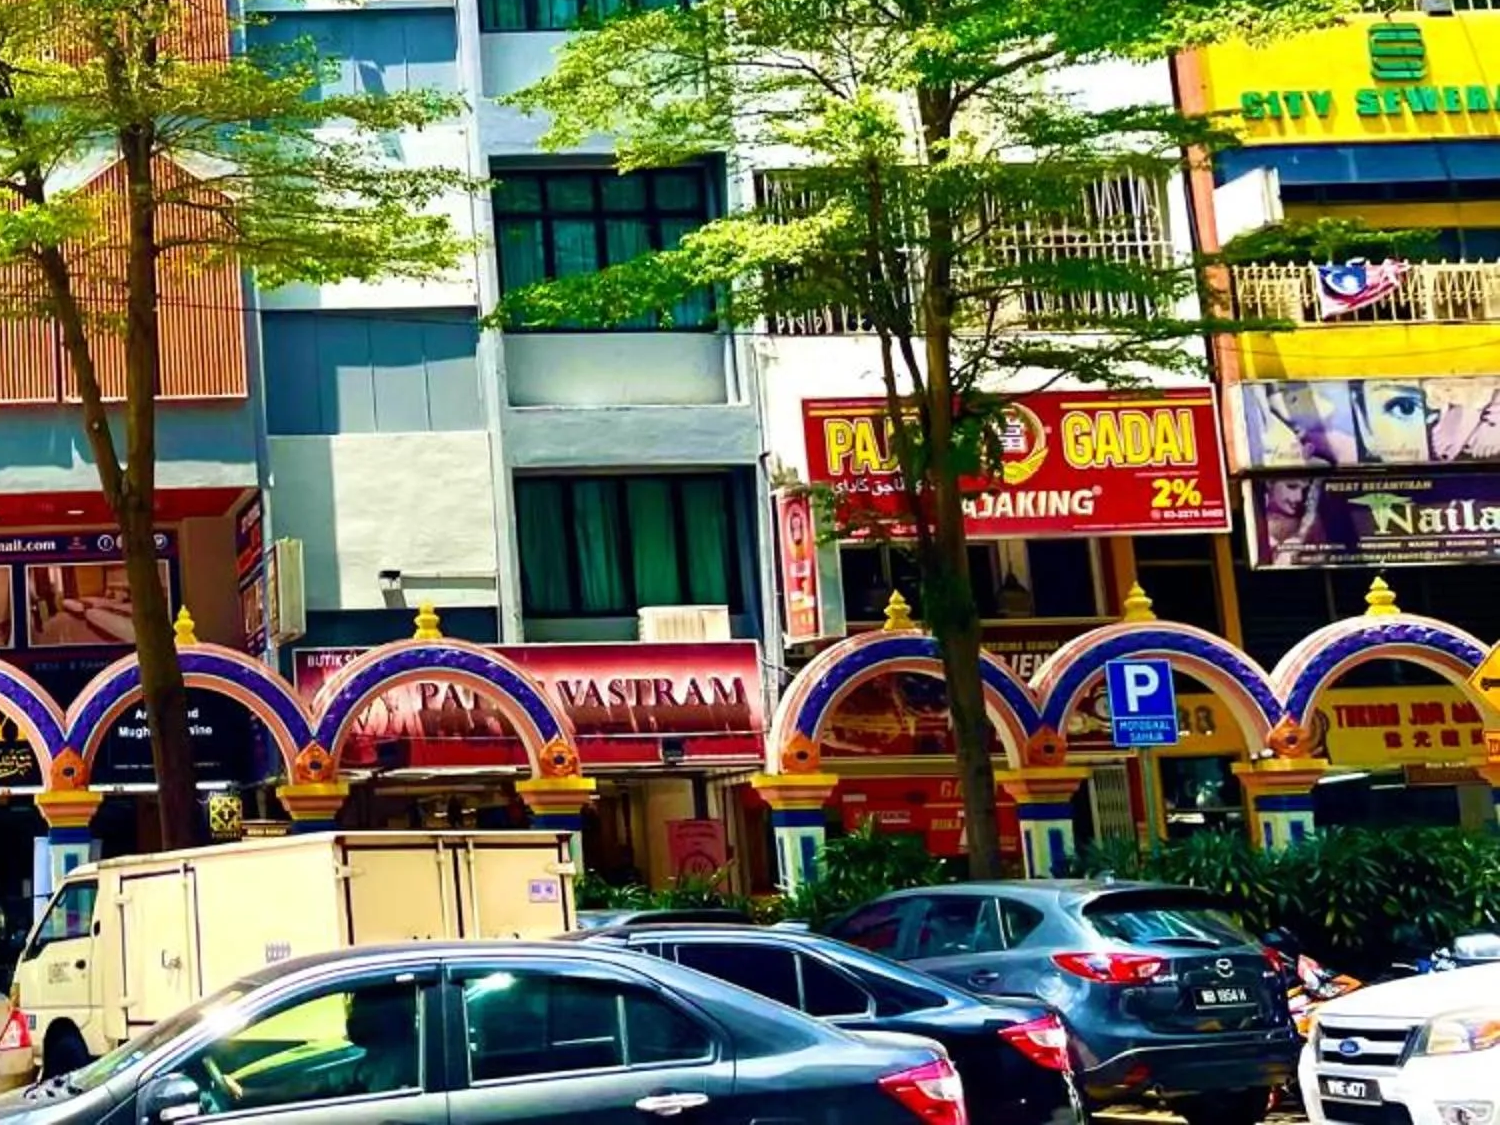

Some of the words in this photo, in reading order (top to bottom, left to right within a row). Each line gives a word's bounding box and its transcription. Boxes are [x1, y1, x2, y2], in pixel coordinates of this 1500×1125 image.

[1061, 409, 1198, 468] GADAI
[1151, 478, 1202, 508] 2%
[308, 654, 341, 667] BUTIK
[557, 677, 747, 707] VASTRAM
[1124, 665, 1159, 712] P
